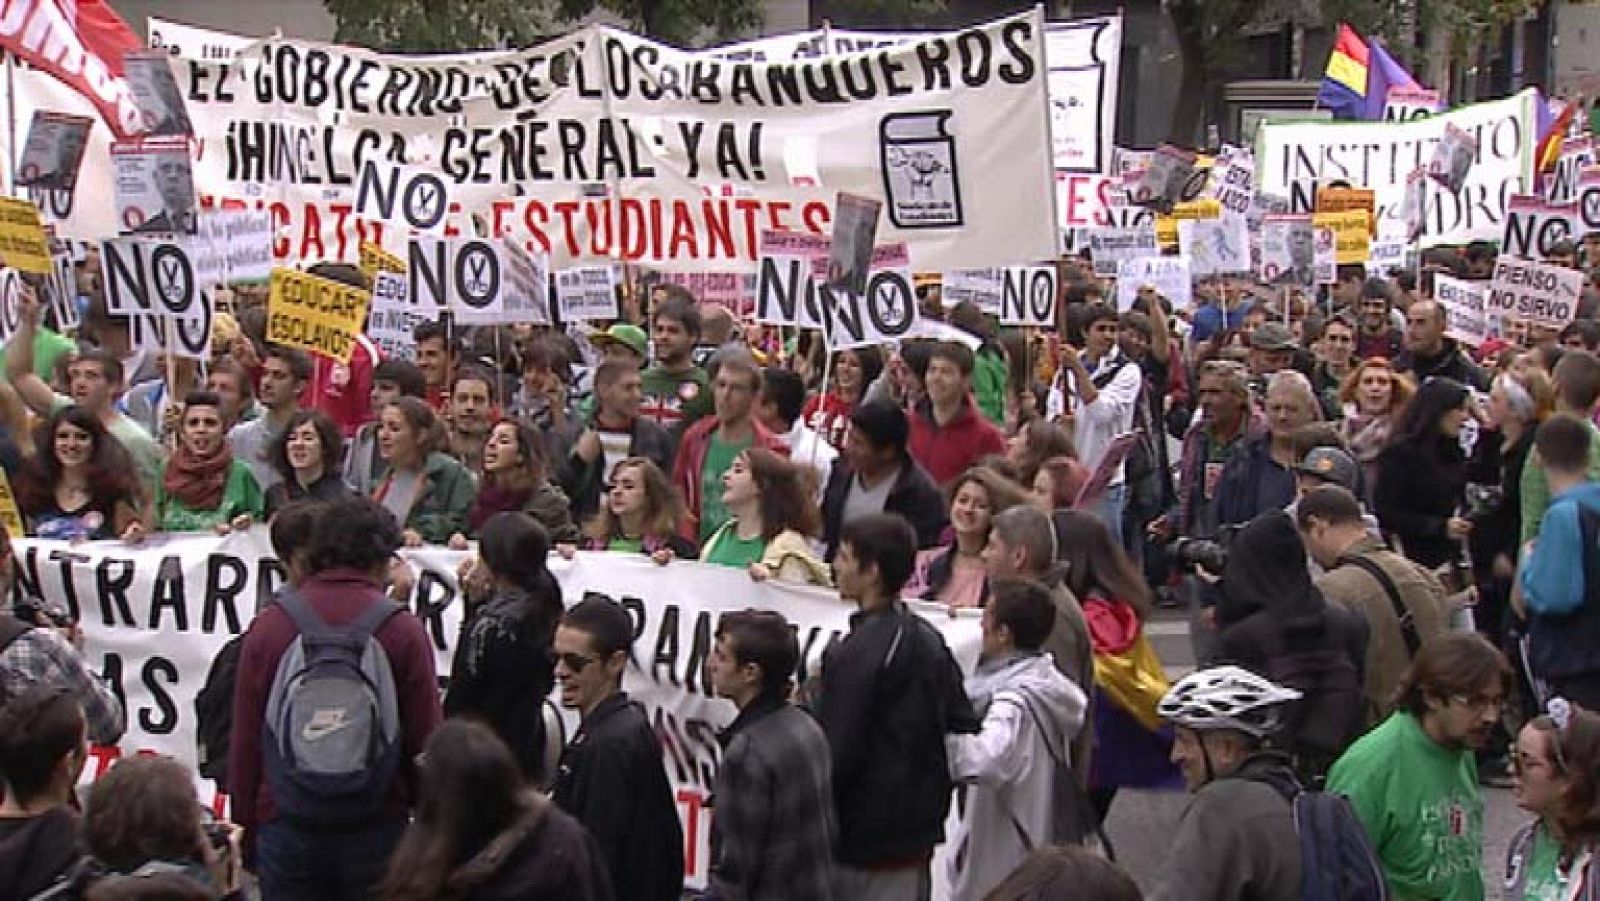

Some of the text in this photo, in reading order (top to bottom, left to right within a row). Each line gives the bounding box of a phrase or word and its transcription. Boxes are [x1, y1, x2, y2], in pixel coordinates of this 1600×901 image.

[441, 119, 656, 184] GENERAL
[681, 122, 767, 182] YA!
[358, 160, 447, 229] NO
[103, 242, 194, 313] NO
[280, 275, 358, 322] EDUCAR
[409, 240, 500, 308] NO
[820, 271, 915, 341] NO
[1003, 268, 1054, 323] NO
